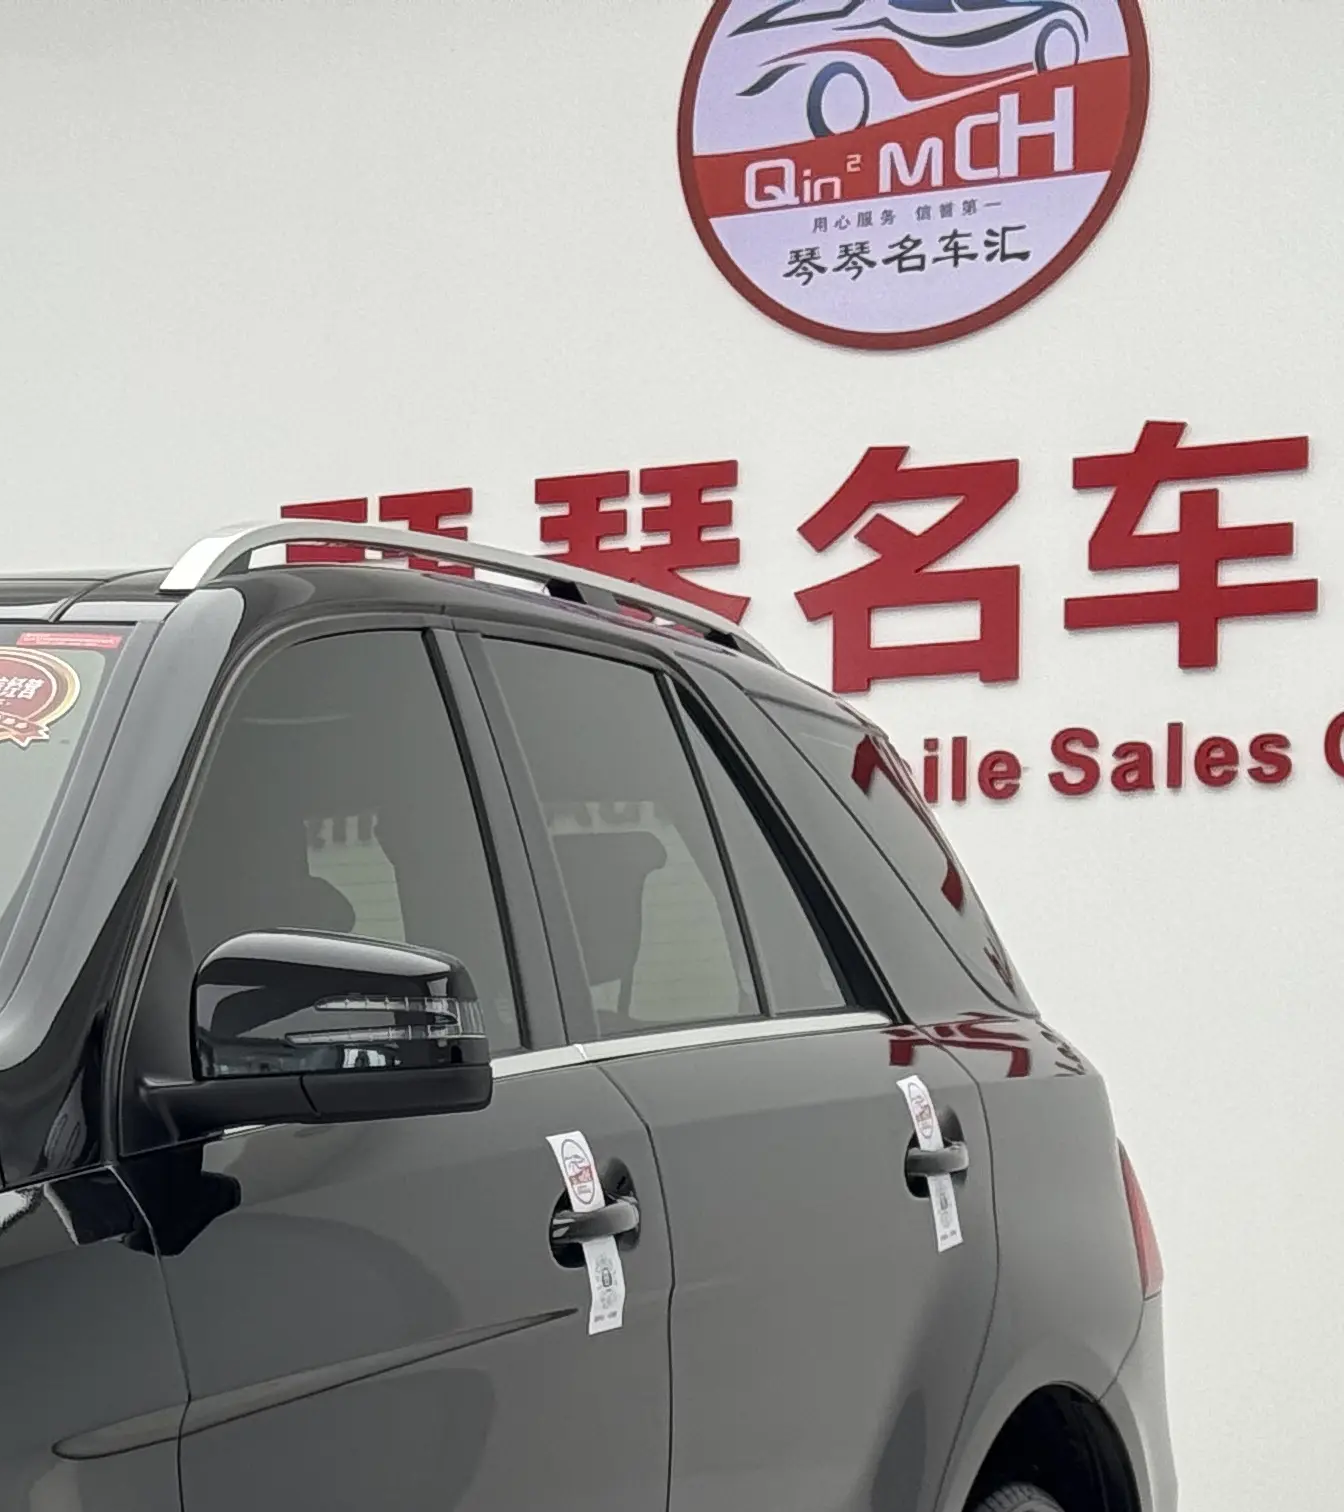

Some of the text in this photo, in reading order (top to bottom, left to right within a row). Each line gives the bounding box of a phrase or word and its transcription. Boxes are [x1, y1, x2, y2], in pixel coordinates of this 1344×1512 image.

[878, 85, 1075, 194] MCH
[812, 199, 1003, 234] 用心服务 信誉第一
[782, 224, 1032, 287] 琴琴名车汇
[903, 735, 1023, 804] ile
[1048, 721, 1293, 796] Sales
